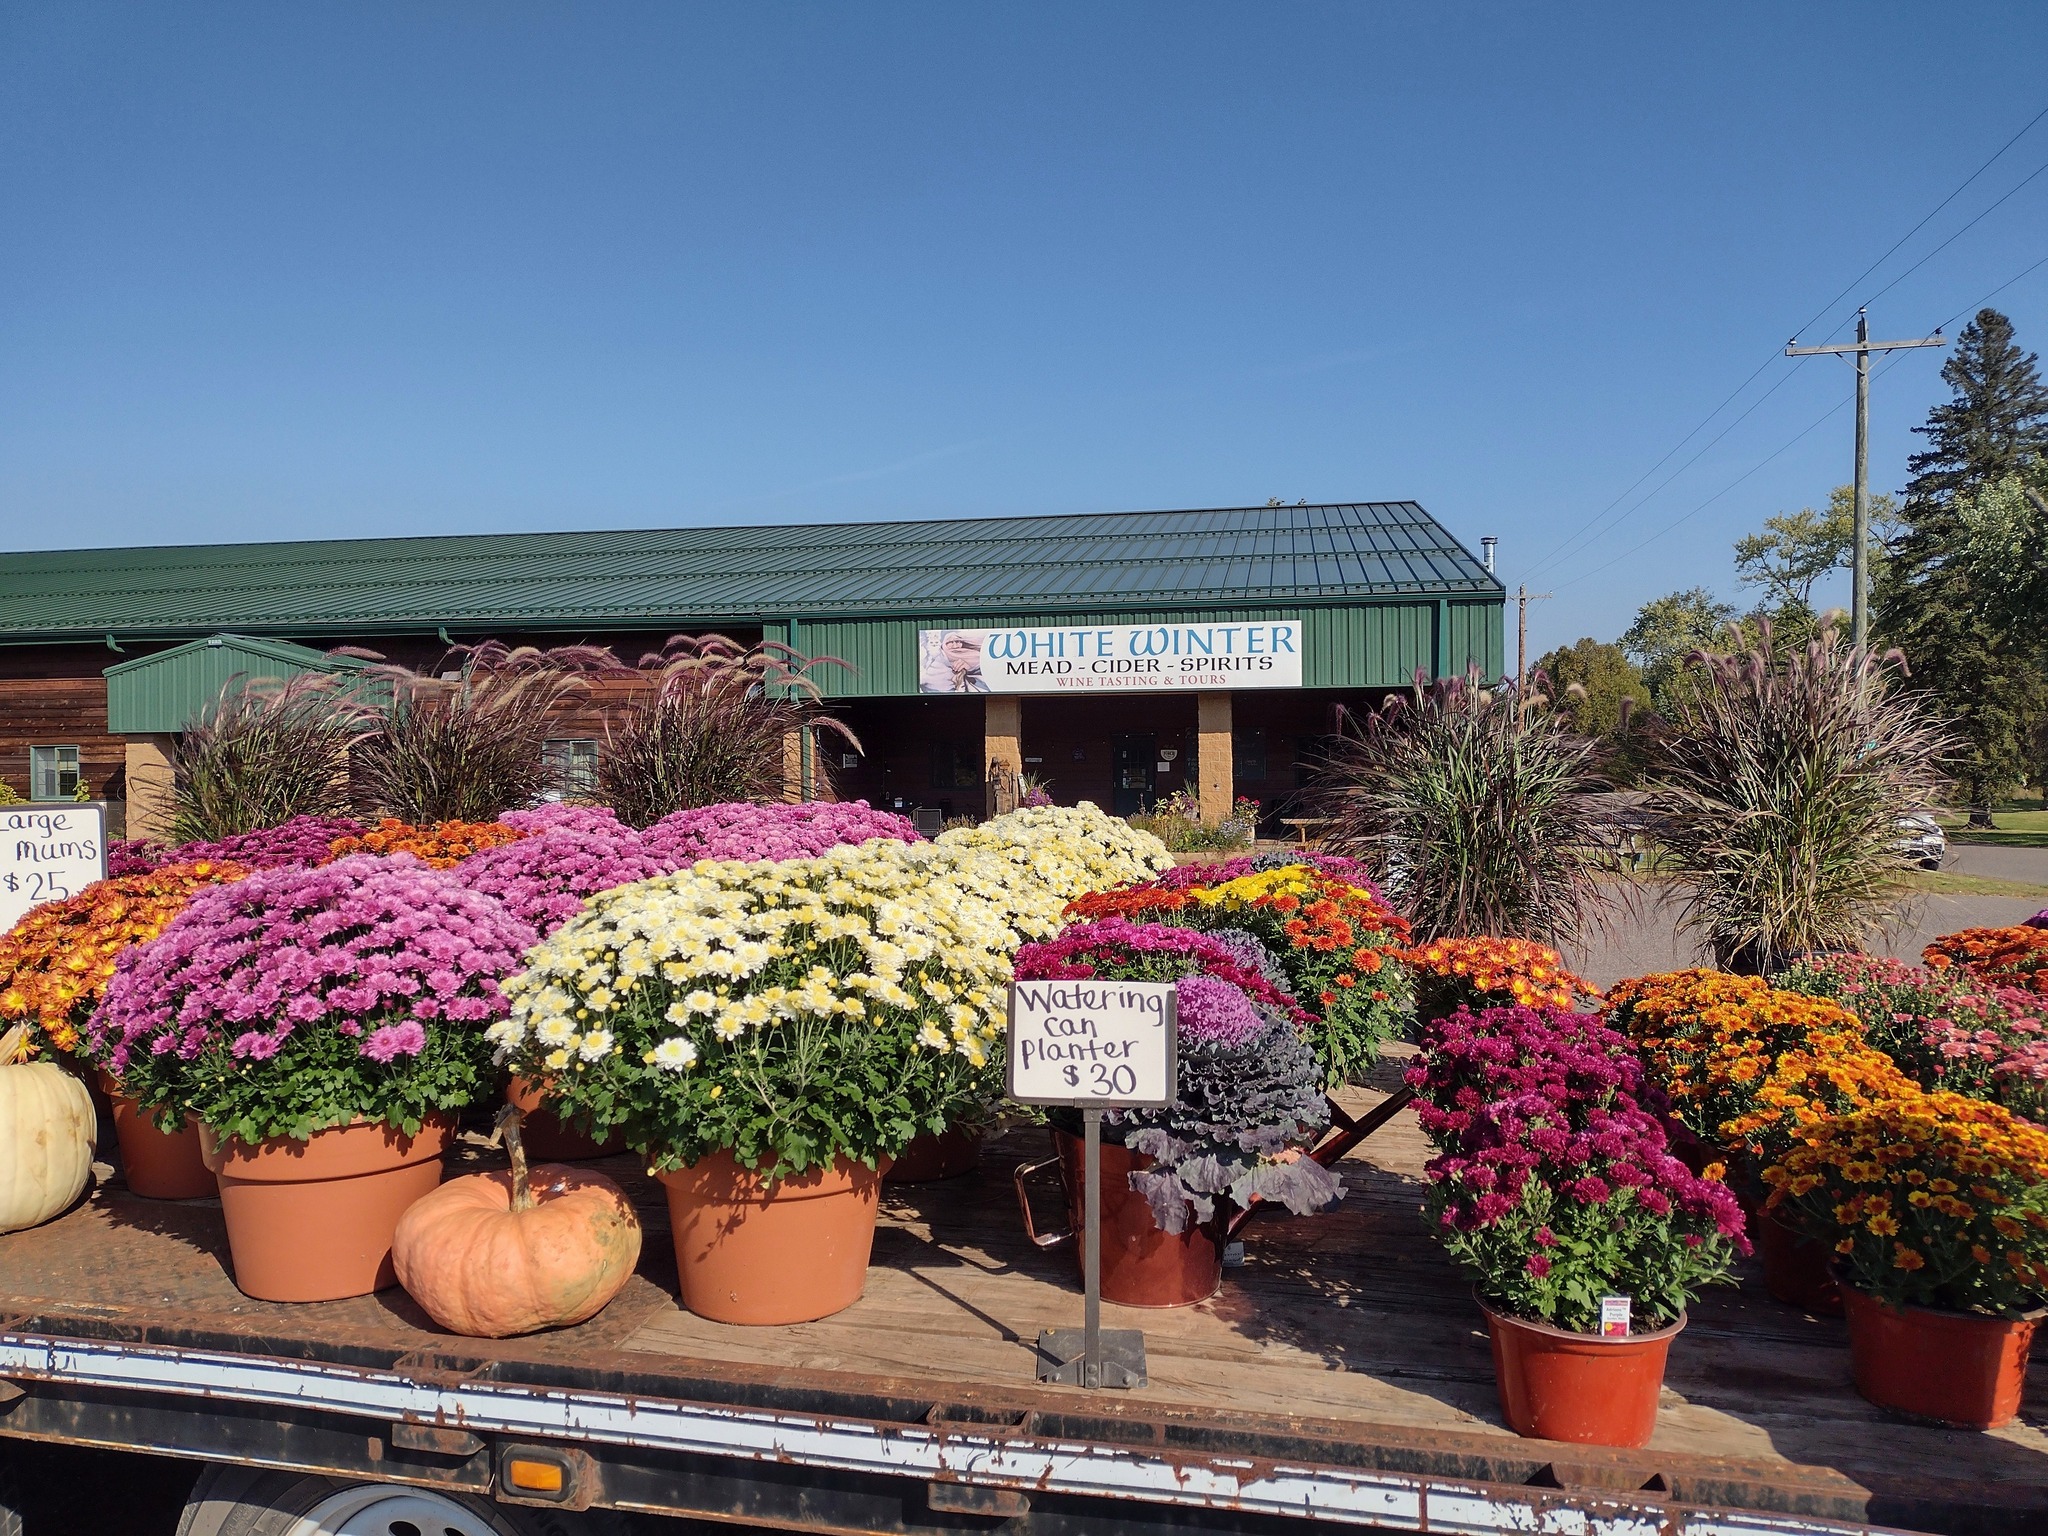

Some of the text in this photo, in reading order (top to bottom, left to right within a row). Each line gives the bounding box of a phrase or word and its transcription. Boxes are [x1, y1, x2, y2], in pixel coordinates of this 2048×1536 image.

[988, 626, 1296, 659] WHITE WINTER
[1006, 660, 1073, 675] MEAD
[1091, 658, 1161, 674] CIDER
[1180, 656, 1273, 672] SPIRITS
[1056, 674, 1226, 687] WINE TASTING & TOURS
[0, 814, 73, 839] arge
[1016, 983, 1164, 1027] Watering
